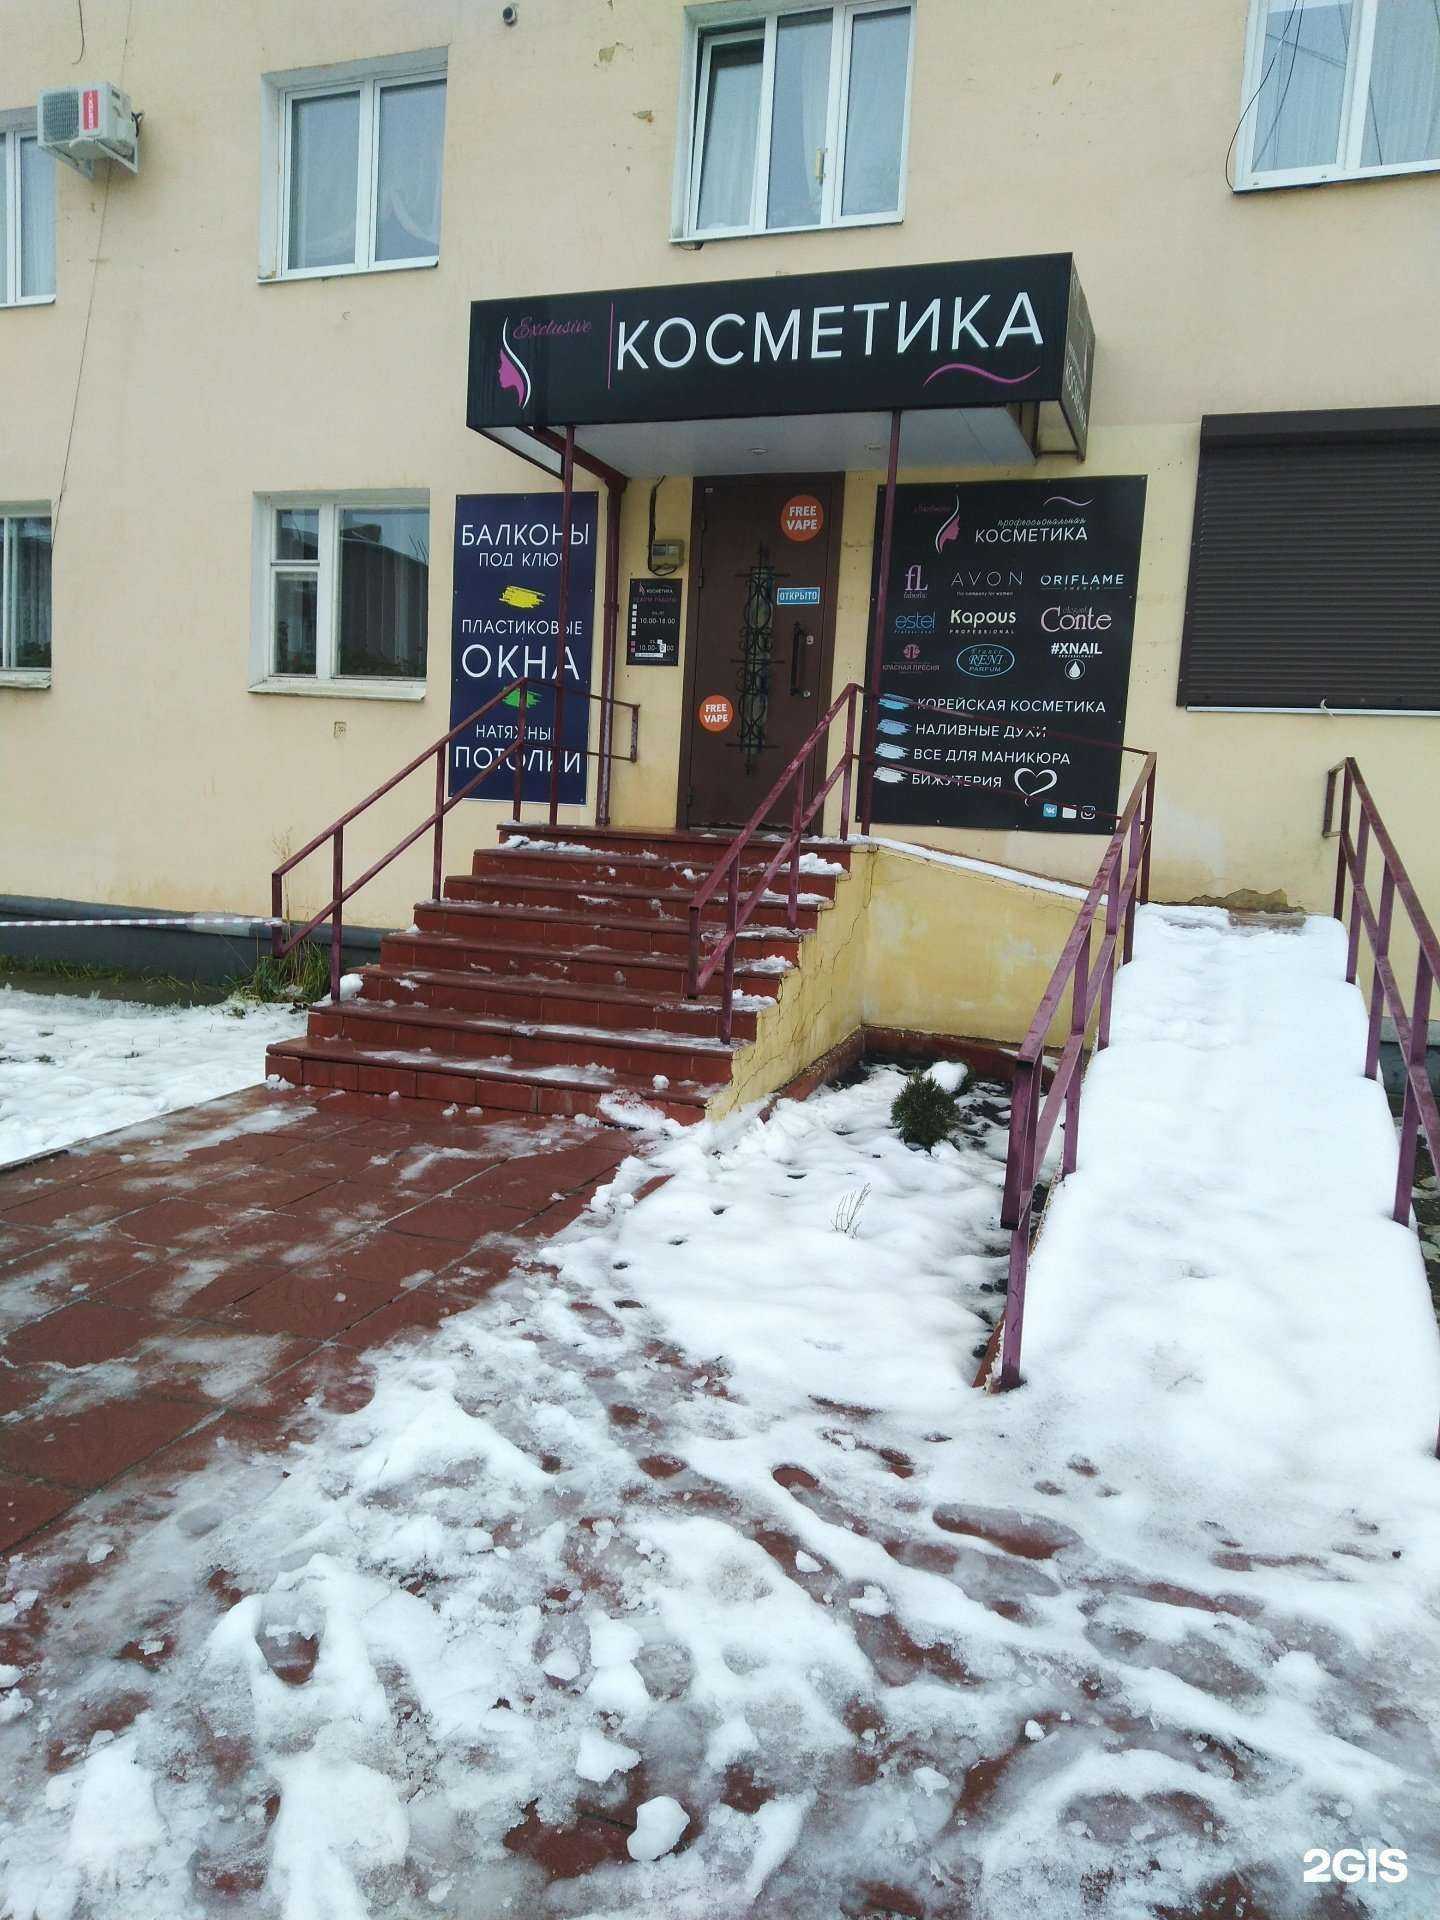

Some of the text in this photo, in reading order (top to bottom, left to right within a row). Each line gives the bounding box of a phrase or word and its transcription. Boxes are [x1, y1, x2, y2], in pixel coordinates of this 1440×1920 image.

[512, 316, 593, 340] Exclusive
[616, 291, 1045, 372] КОСМЕТИКА
[788, 505, 817, 517] FREE
[786, 519, 818, 531] VAPE
[975, 526, 1088, 543] КОСМЕТИКА
[479, 552, 563, 567] ПОД КЛЮ
[951, 571, 1023, 587] AVON
[1040, 574, 1124, 586] ORIFLAME
[779, 591, 818, 601] ОТКРЫТО
[895, 611, 936, 630] estel
[950, 609, 1016, 628] Kapous
[1040, 606, 1112, 633] Conte
[1051, 643, 1103, 655] #XNAIL
[461, 643, 580, 680] ОКНА
[705, 704, 727, 713] FREE
[917, 697, 1106, 713] КОРЕЙСКАЯ КОСМЕТИКА
[704, 713, 728, 724] VAPE
[915, 723, 1000, 737] НАЛИВНЫЕ
[913, 749, 1071, 765] ВСЕ ДЛЯ МАНИКЮРА
[911, 773, 1002, 788] БИЖУТЕРИЯ
